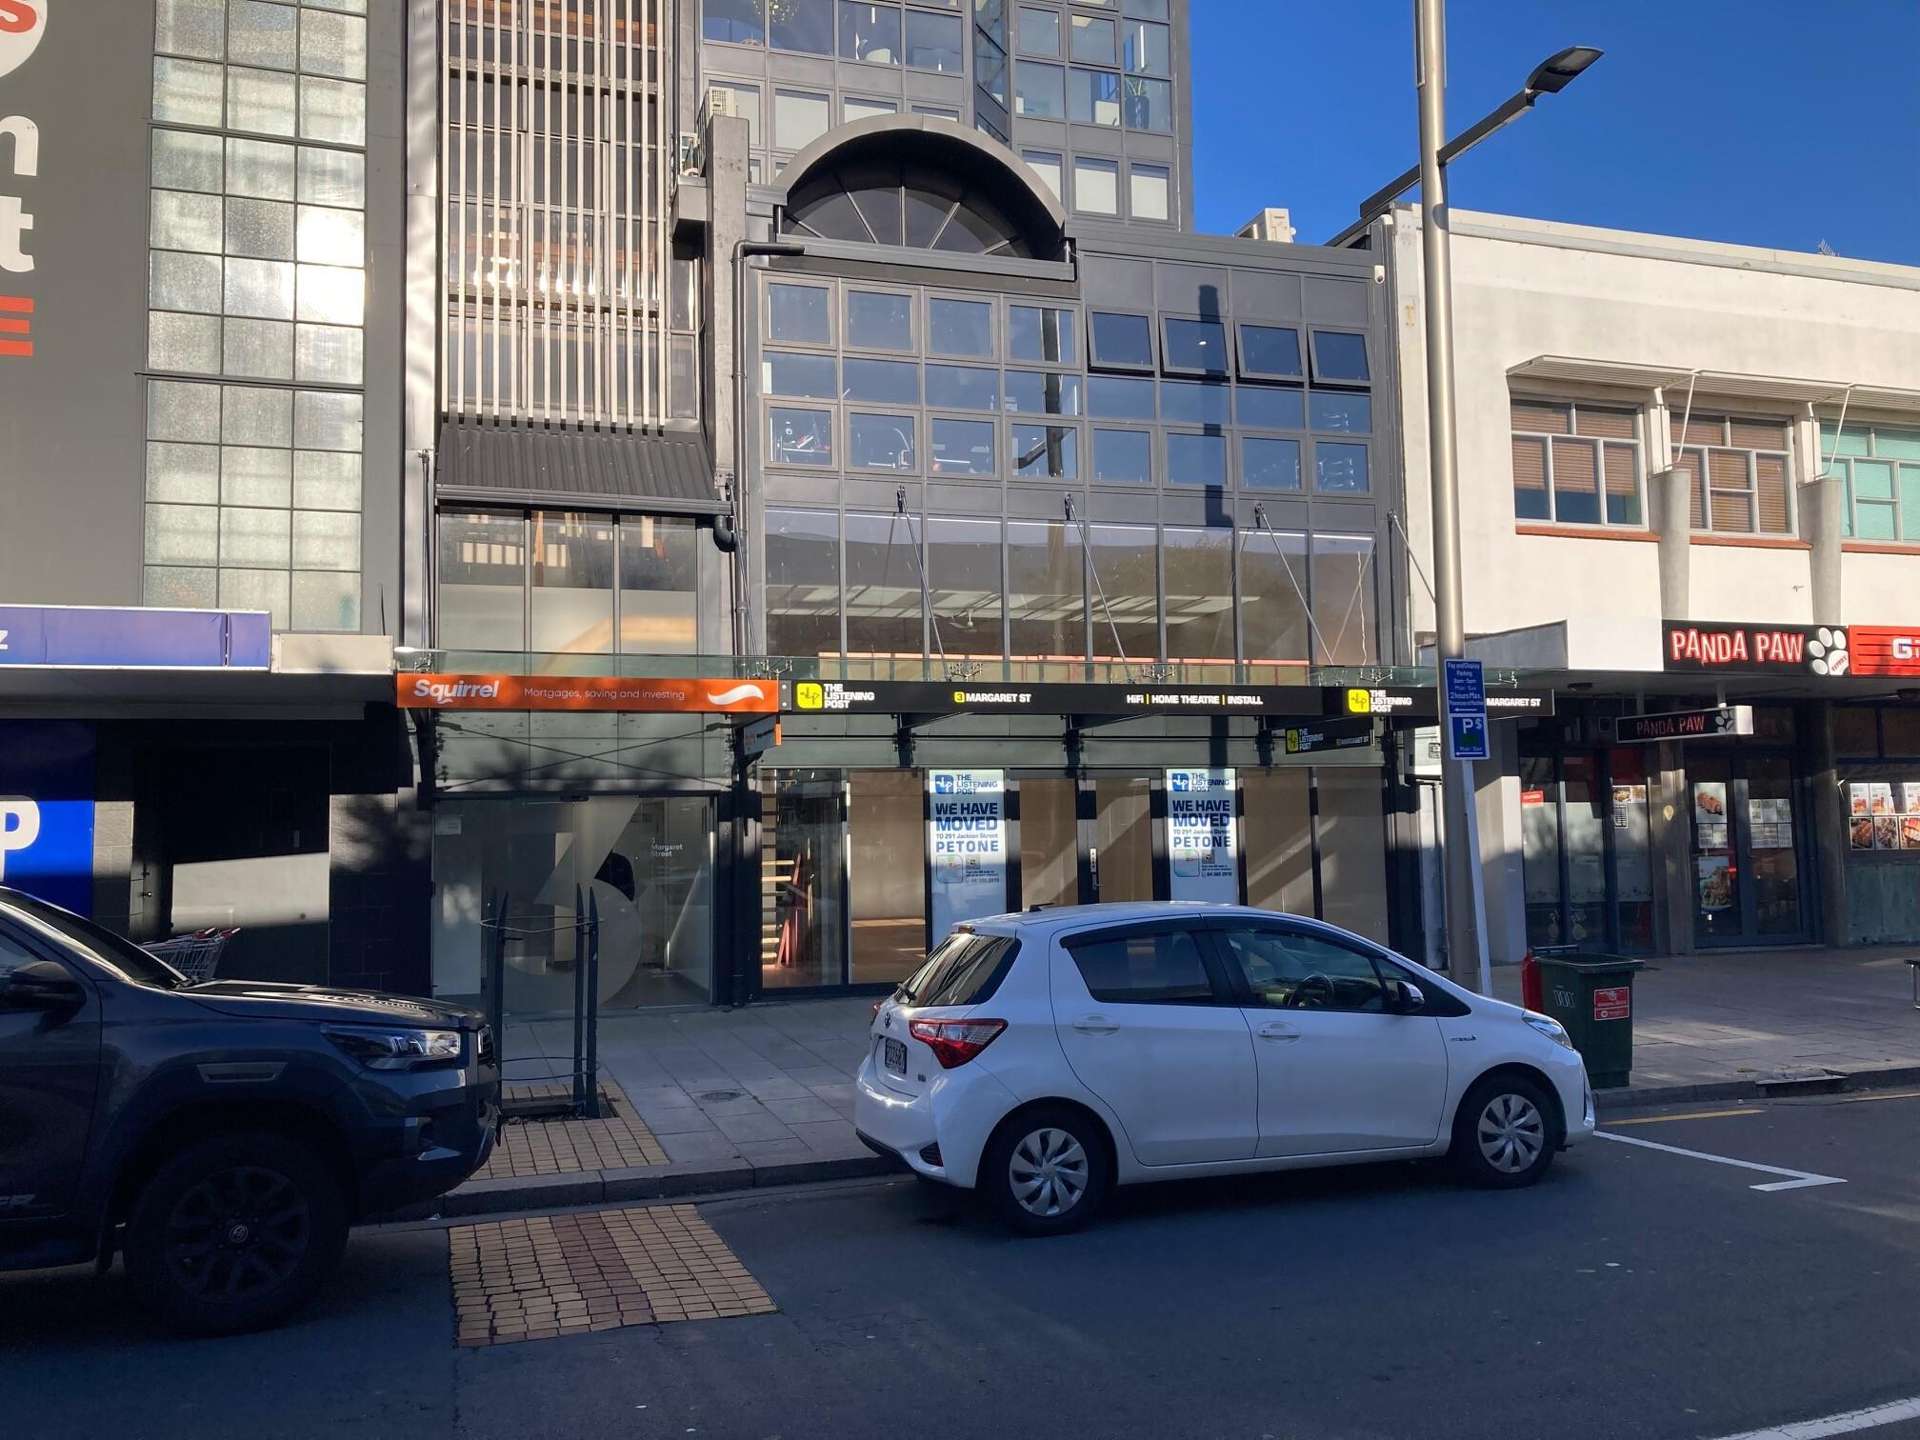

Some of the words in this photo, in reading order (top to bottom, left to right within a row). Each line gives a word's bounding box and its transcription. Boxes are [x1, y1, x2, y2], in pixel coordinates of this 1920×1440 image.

[1670, 628, 1749, 666] PANDA
[1755, 631, 1806, 663] PAW
[414, 679, 500, 703] Squirrel
[523, 687, 581, 699] Mortgages,
[584, 690, 616, 700] saving
[619, 689, 639, 698] and
[642, 689, 685, 700] investing
[824, 683, 843, 691] THE
[824, 692, 875, 701] LISTENING
[966, 693, 1018, 702] MARGARET
[1019, 693, 1031, 703] ST
[1370, 690, 1386, 698] THE
[824, 700, 850, 708] POST
[1152, 695, 1179, 704] HOME
[1181, 695, 1219, 704] THEATRE
[1227, 696, 1263, 705] INSTALL
[1370, 697, 1412, 706] LISTENING
[1486, 699, 1529, 707] MARGARET
[1530, 698, 1541, 707] ST
[1370, 705, 1392, 713] POST
[1636, 717, 1674, 736] PANDA
[1679, 715, 1704, 732] PAW
[935, 803, 957, 814] WE
[960, 803, 998, 814] HAVE
[1172, 800, 1193, 811] WE
[1195, 800, 1230, 811] HAVE
[935, 816, 998, 831] MOVED
[1172, 813, 1230, 827] MOVED
[936, 841, 999, 852] PETONE
[1173, 836, 1231, 848] PETONE
